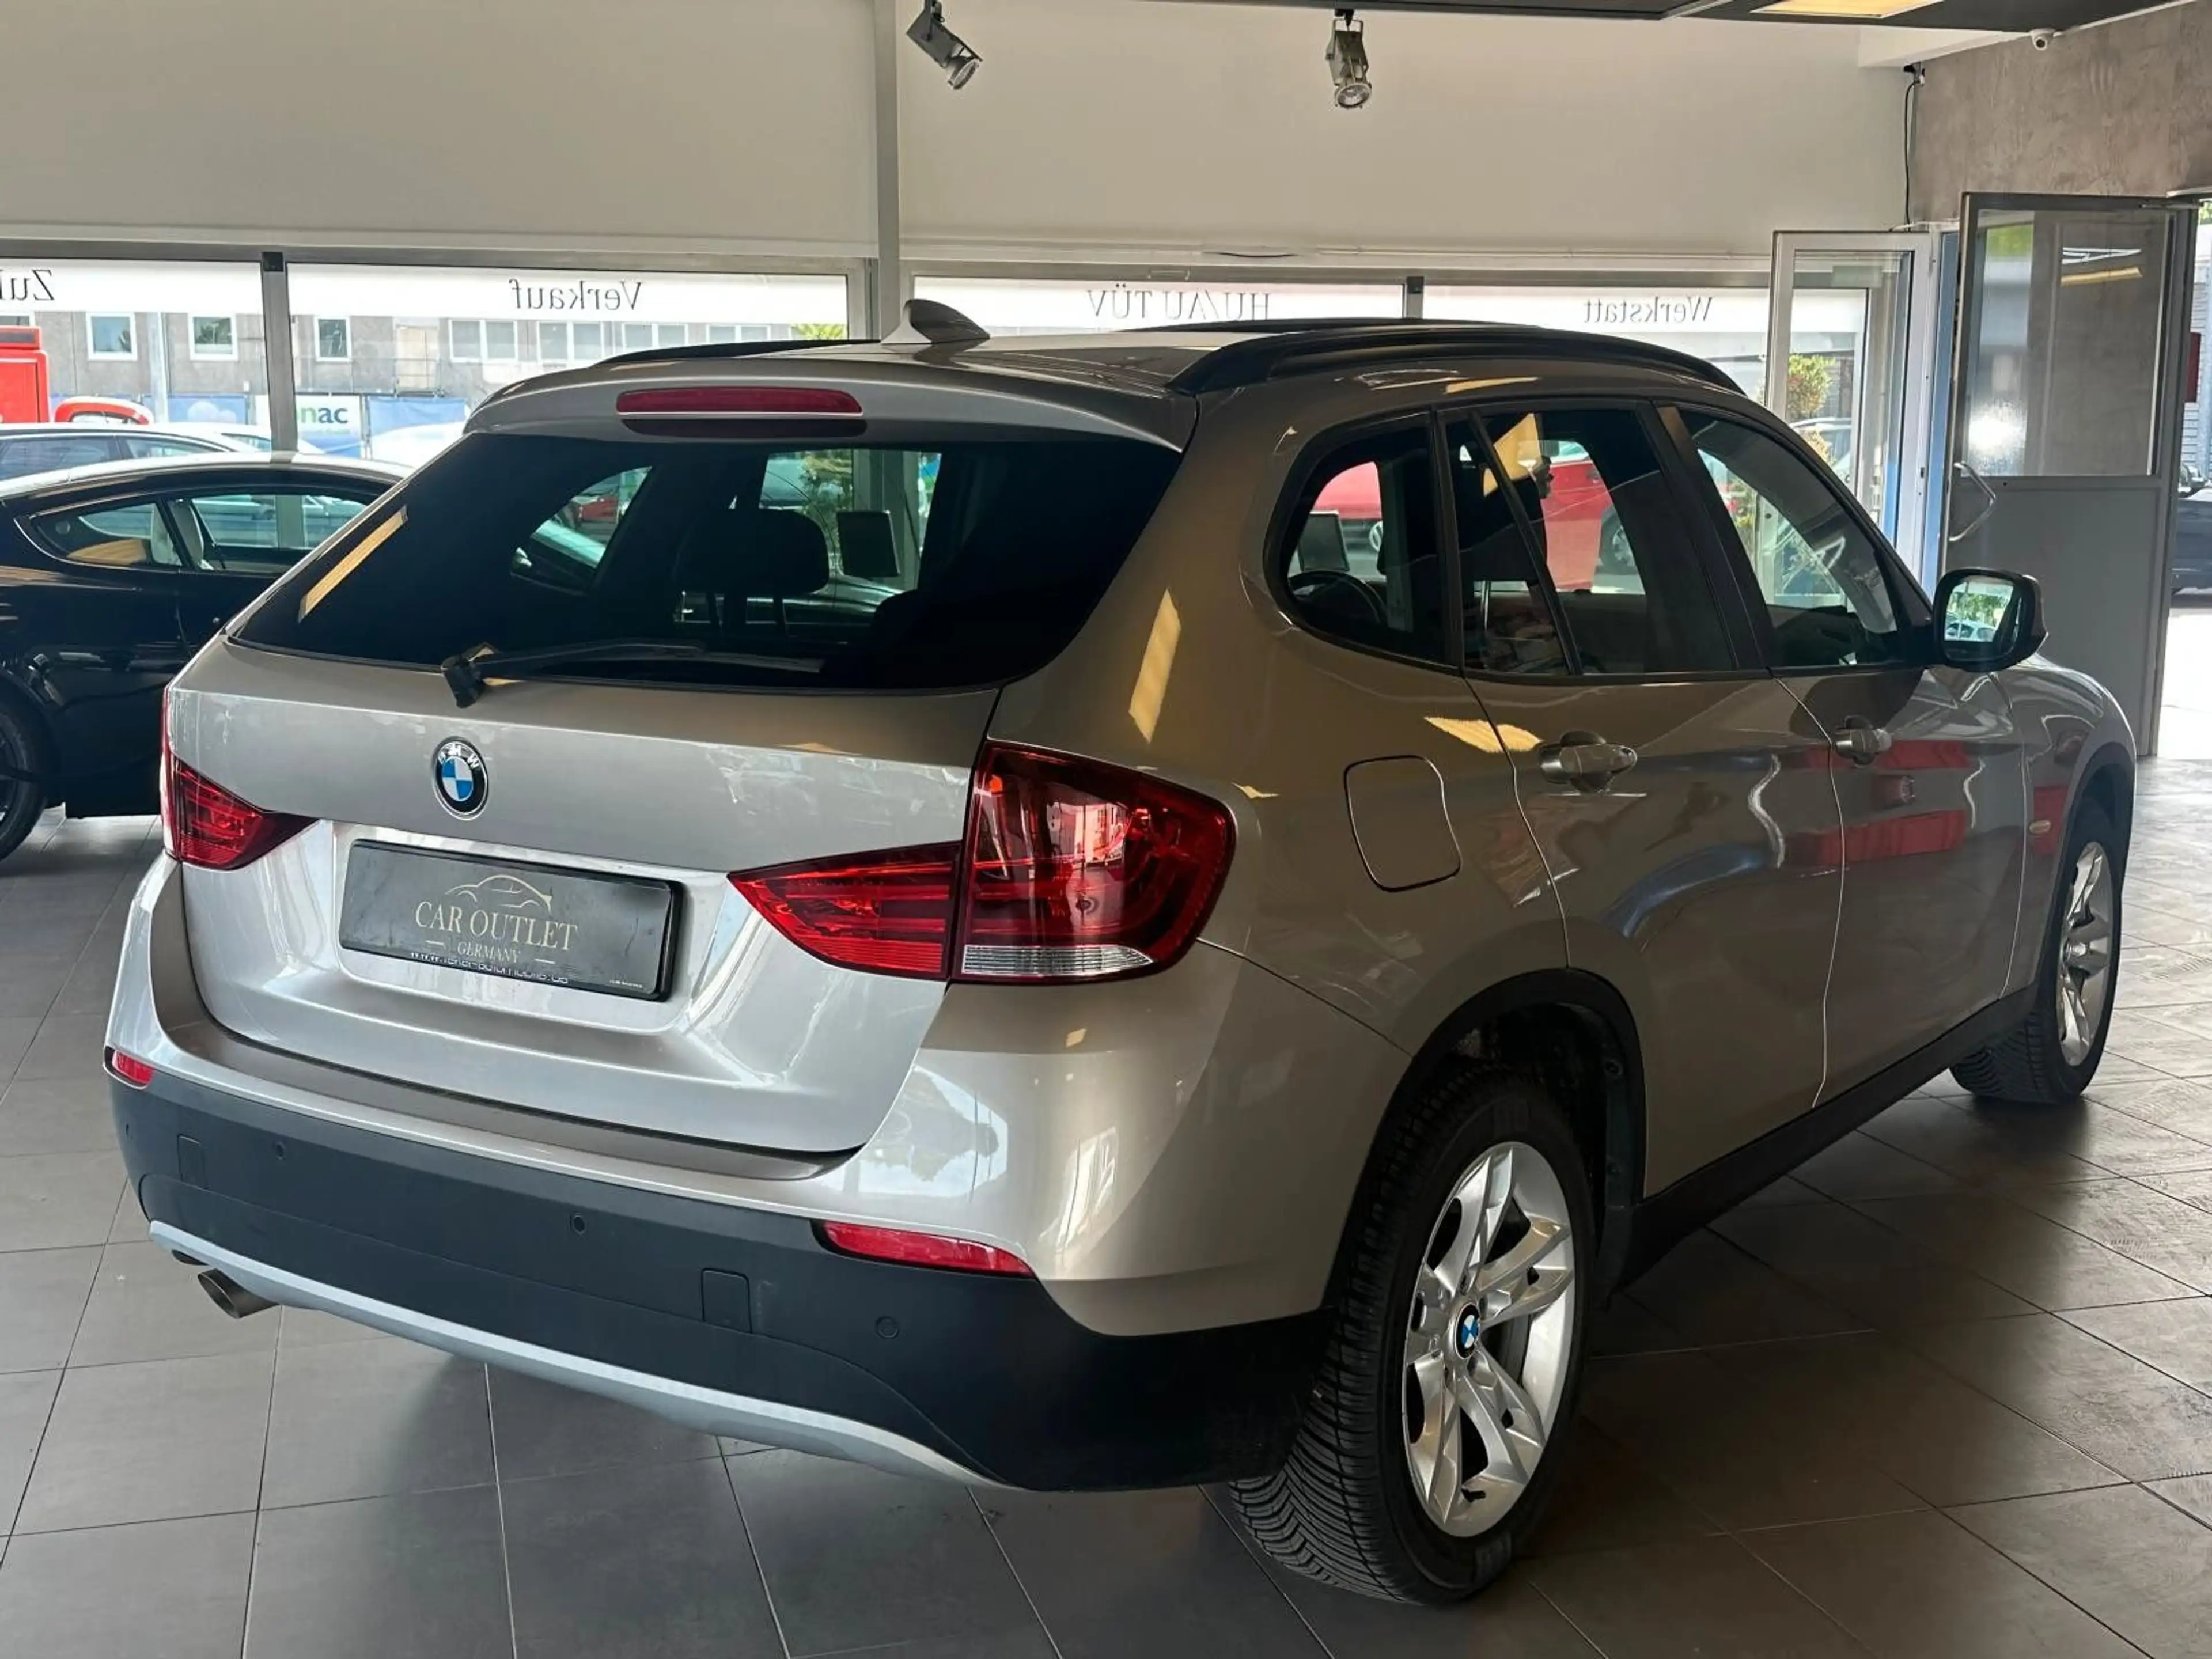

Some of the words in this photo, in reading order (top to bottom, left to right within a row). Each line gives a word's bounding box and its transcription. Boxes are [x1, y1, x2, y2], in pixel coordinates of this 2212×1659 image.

[416, 901, 463, 933] CAR
[469, 909, 578, 950] OUTLET
[457, 941, 521, 963] GERMANY
